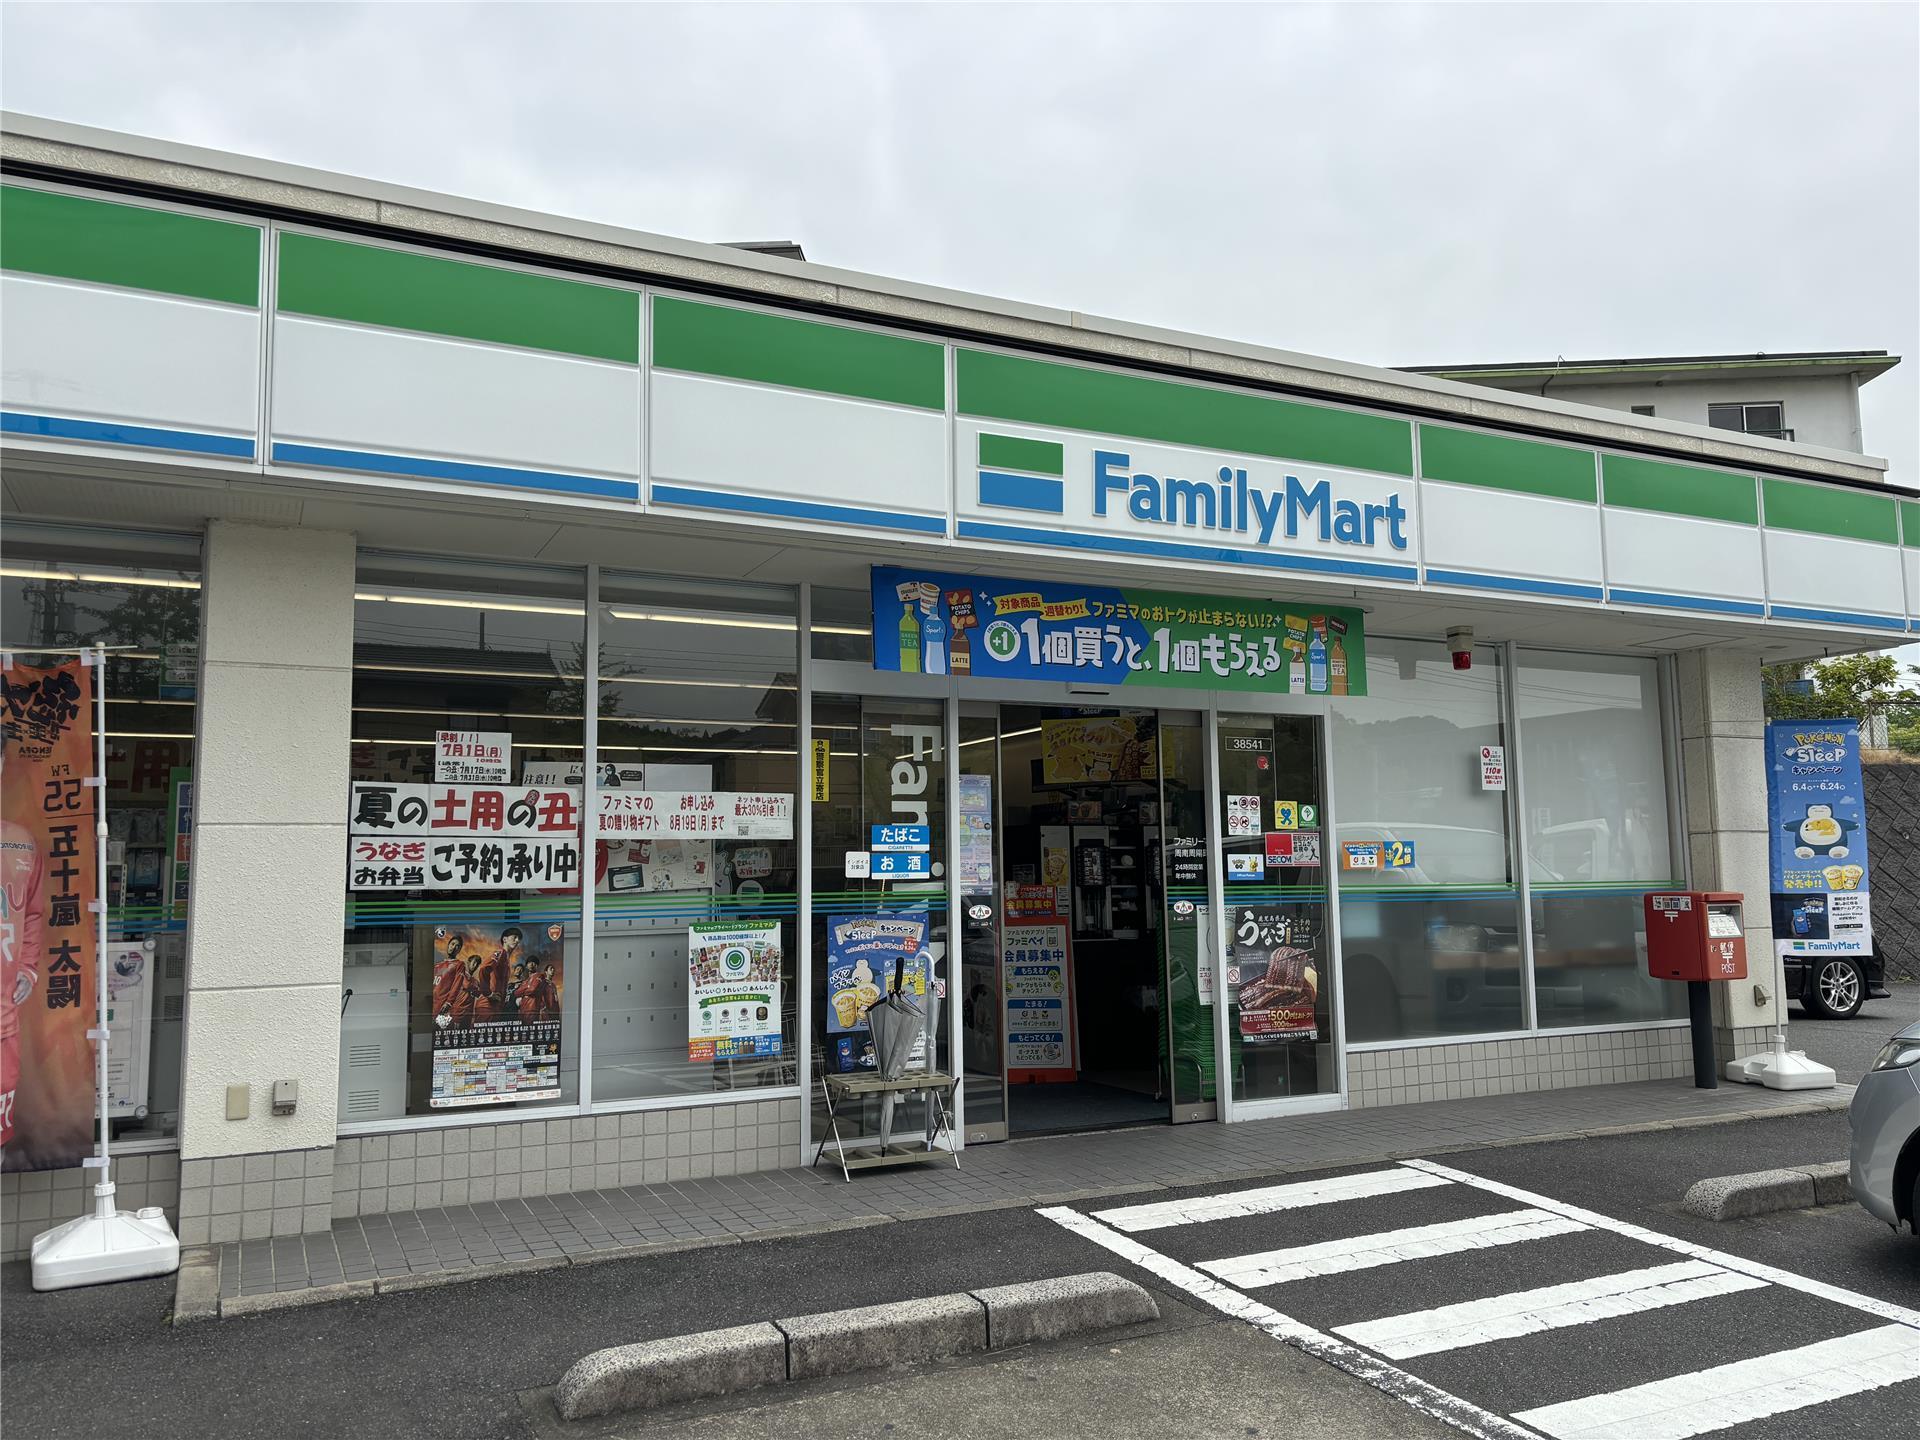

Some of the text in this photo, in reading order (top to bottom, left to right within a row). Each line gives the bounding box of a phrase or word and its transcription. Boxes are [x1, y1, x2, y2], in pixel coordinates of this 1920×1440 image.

[1092, 448, 1408, 550] FamilyMart
[951, 602, 971, 611] POTATO
[1000, 597, 1042, 609] 対象商品
[1044, 604, 1083, 617] 週替わり!
[1091, 600, 1276, 628] ファミマのおトクが止まらない!?
[901, 639, 918, 648] TEA
[992, 630, 1008, 651] +1
[951, 655, 969, 665] LATTE
[1233, 738, 1263, 750] 38541
[1792, 765, 1843, 775] キャンペーン
[353, 786, 578, 832] 夏の土用の丑
[603, 795, 653, 811] ファミマの
[680, 795, 715, 811] お申し込み
[598, 814, 660, 831] 夏の贈り物ギフト
[880, 827, 921, 842] たばこ
[1174, 837, 1206, 846] ファミリー
[355, 841, 427, 861] うなぎ
[431, 842, 577, 884] ご予約承り中
[1268, 855, 1292, 863] SECOM
[354, 865, 425, 885] お弁当
[1783, 879, 1823, 889] 発売中!!
[749, 921, 774, 929] ファミマル
[880, 924, 916, 934] キャンペーン
[1238, 910, 1291, 946] うなぎ
[1006, 936, 1045, 946] ファミペイ
[1720, 941, 1734, 953] 郵便
[1807, 941, 1861, 951] FamilyMart
[1004, 949, 1065, 962] 会員募集中
[1721, 963, 1736, 974] POST
[1024, 1000, 1047, 1008] たまる!
[1018, 1034, 1055, 1042] もどってくる!
